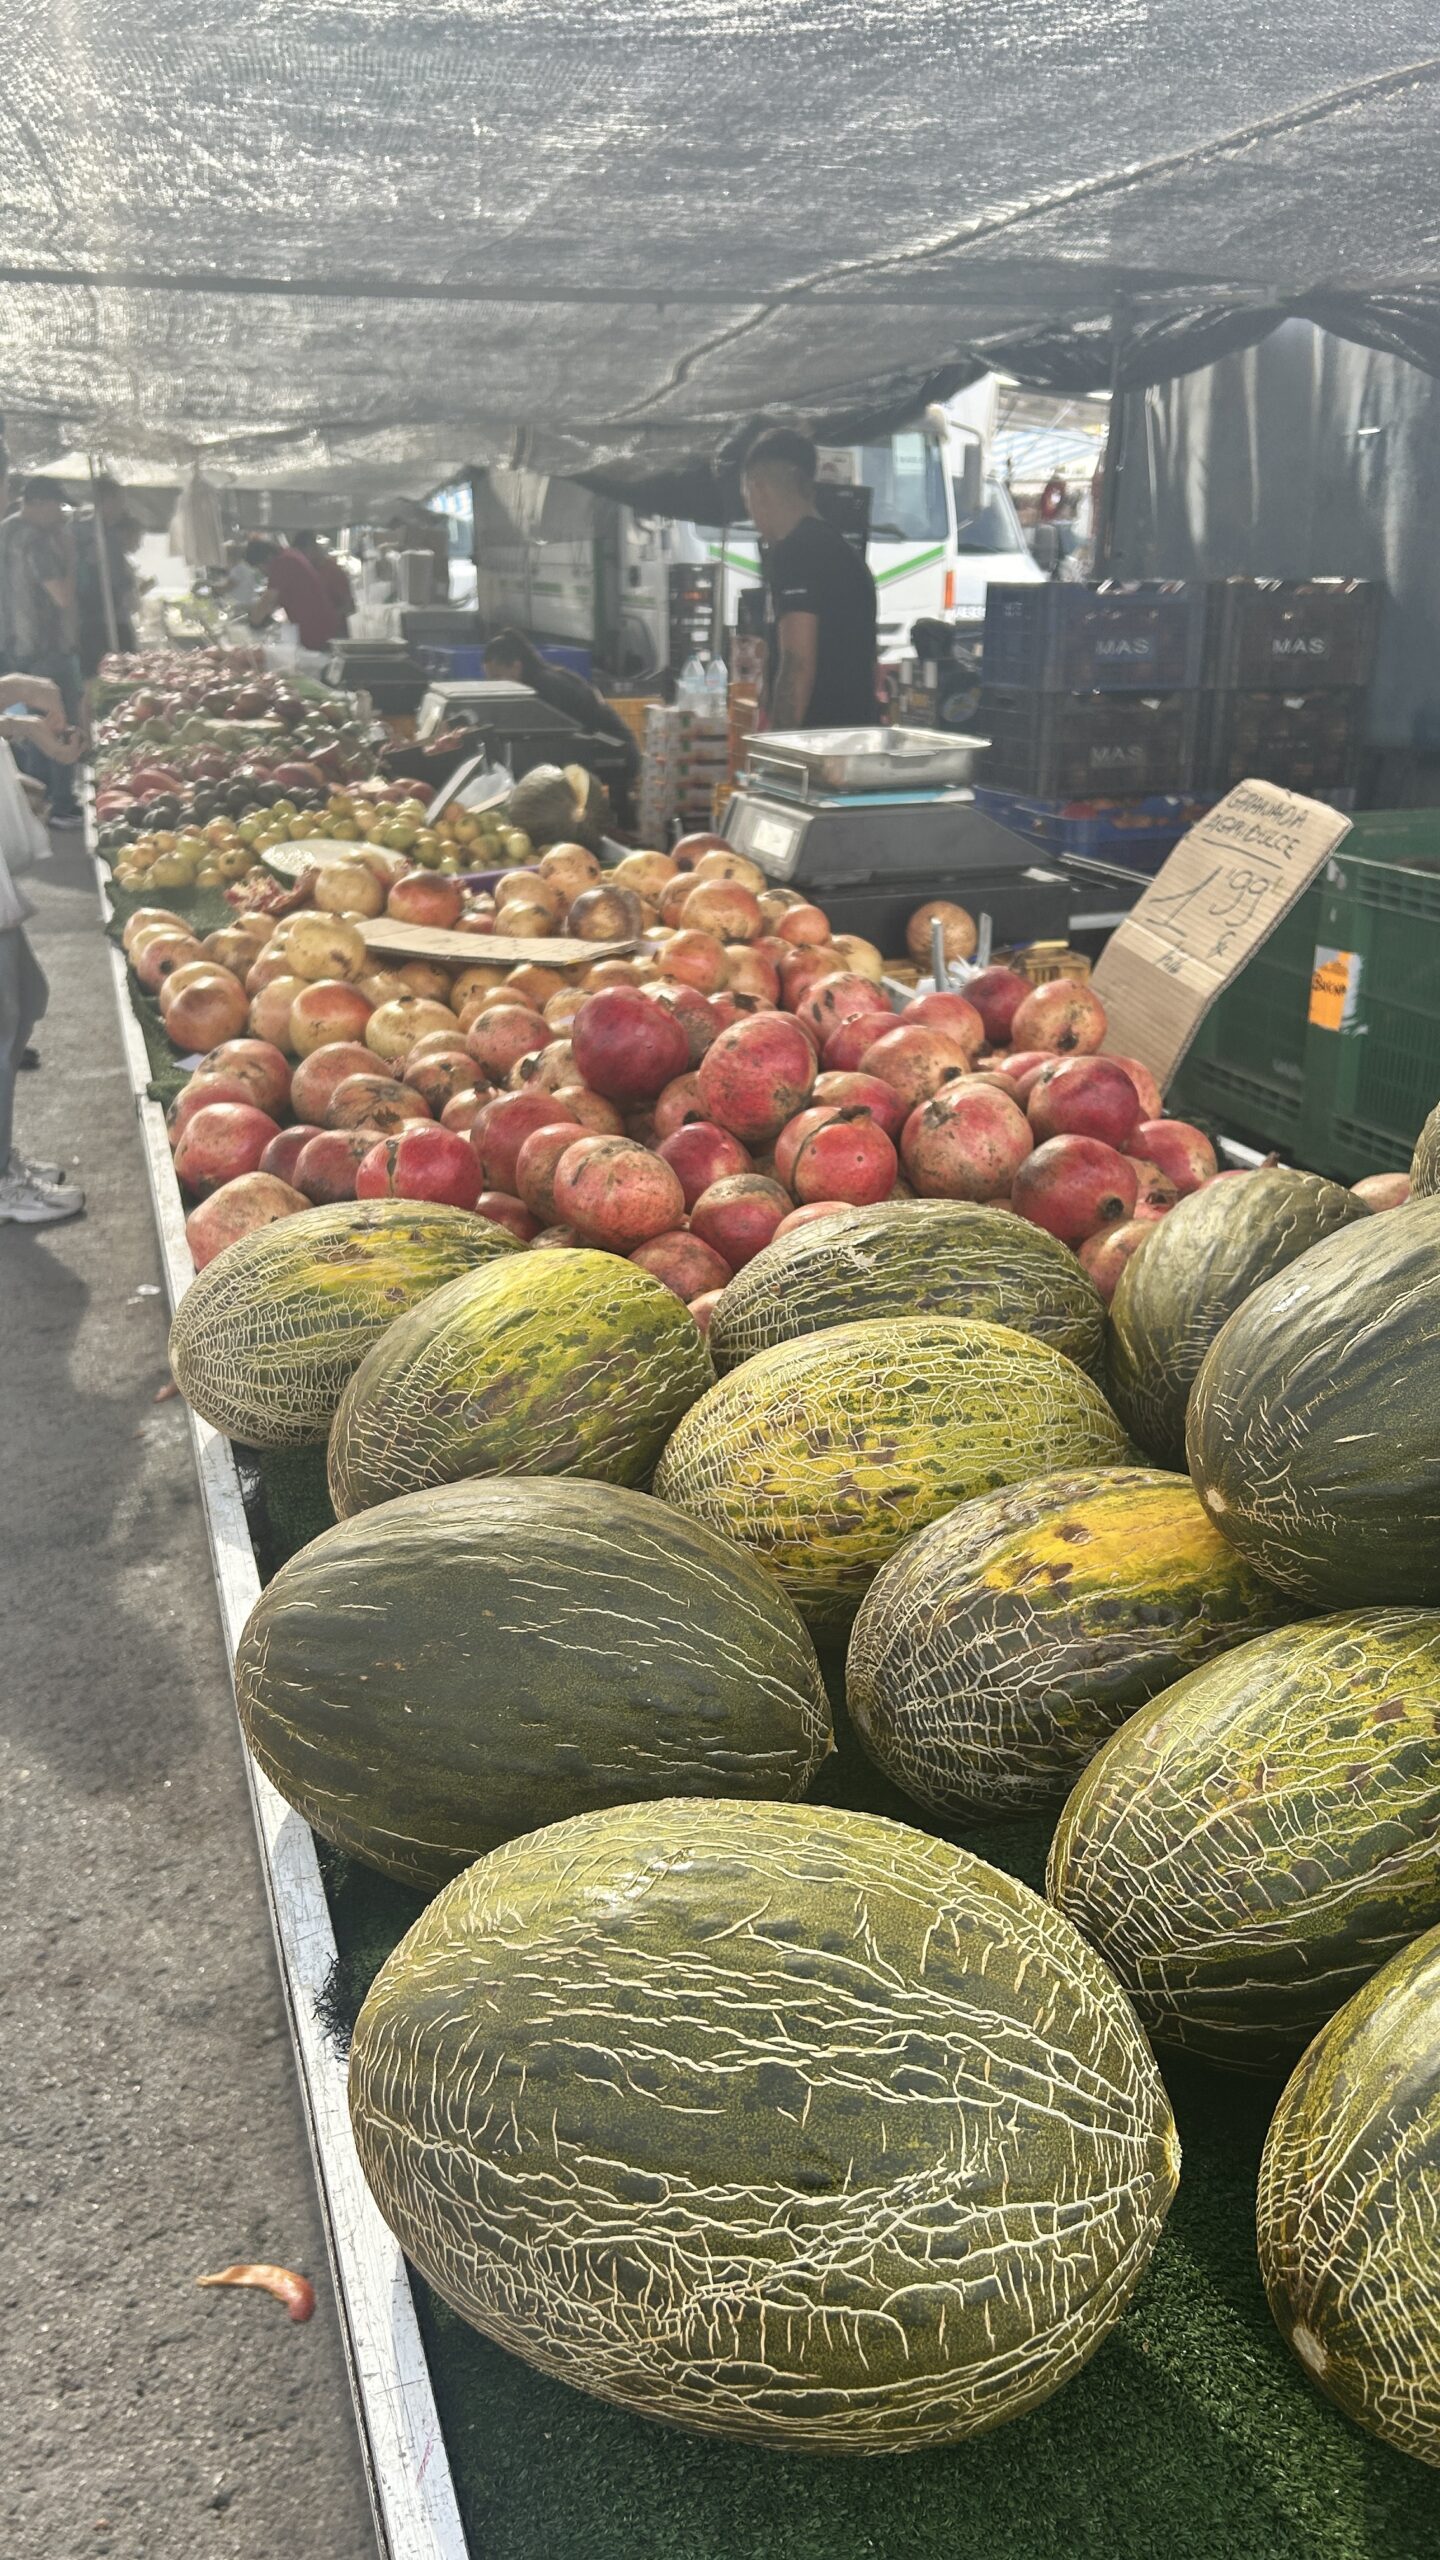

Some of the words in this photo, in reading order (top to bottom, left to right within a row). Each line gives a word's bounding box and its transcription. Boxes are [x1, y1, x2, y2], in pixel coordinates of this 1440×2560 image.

[1096, 638, 1150, 655] MAS
[1271, 638, 1326, 655] MAS
[1091, 745, 1144, 763] MAS
[1224, 787, 1308, 829] GRANADA
